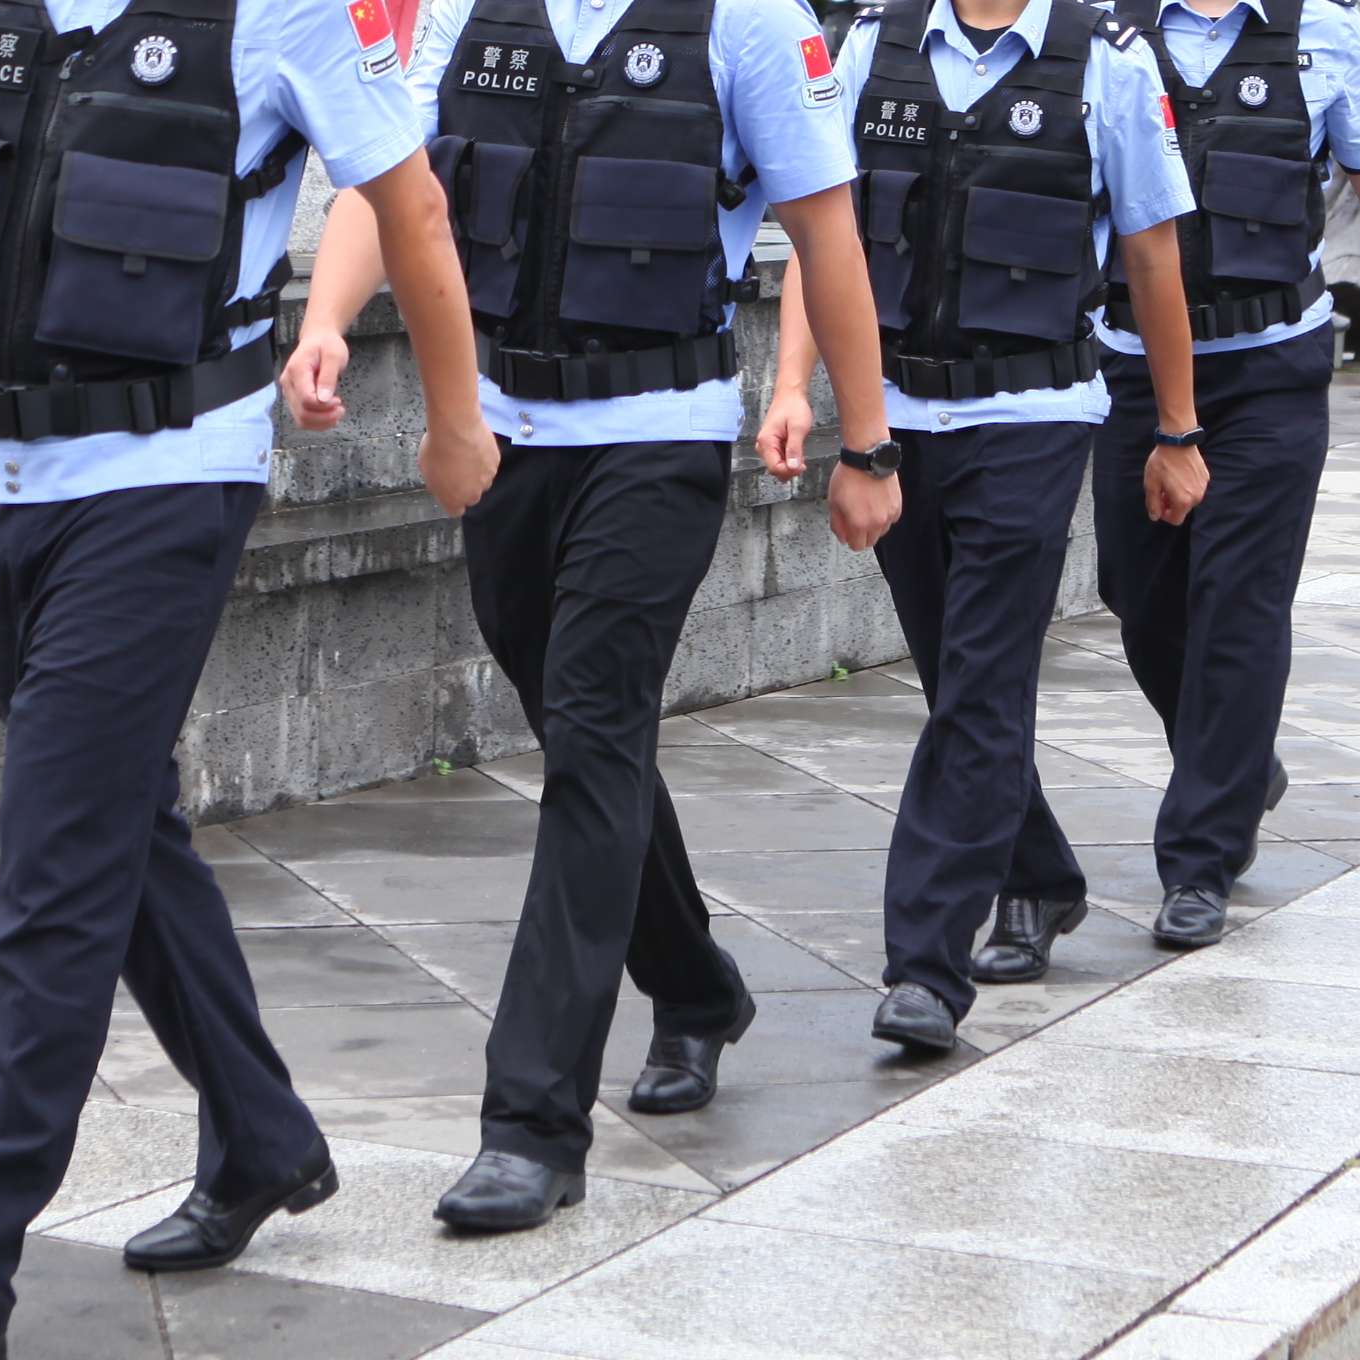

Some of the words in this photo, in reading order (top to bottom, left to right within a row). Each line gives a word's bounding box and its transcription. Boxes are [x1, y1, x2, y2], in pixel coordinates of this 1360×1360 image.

[483, 46, 529, 70] 警察
[462, 70, 538, 92] POLICE
[880, 100, 920, 122] 警察
[863, 122, 927, 141] POLICE
